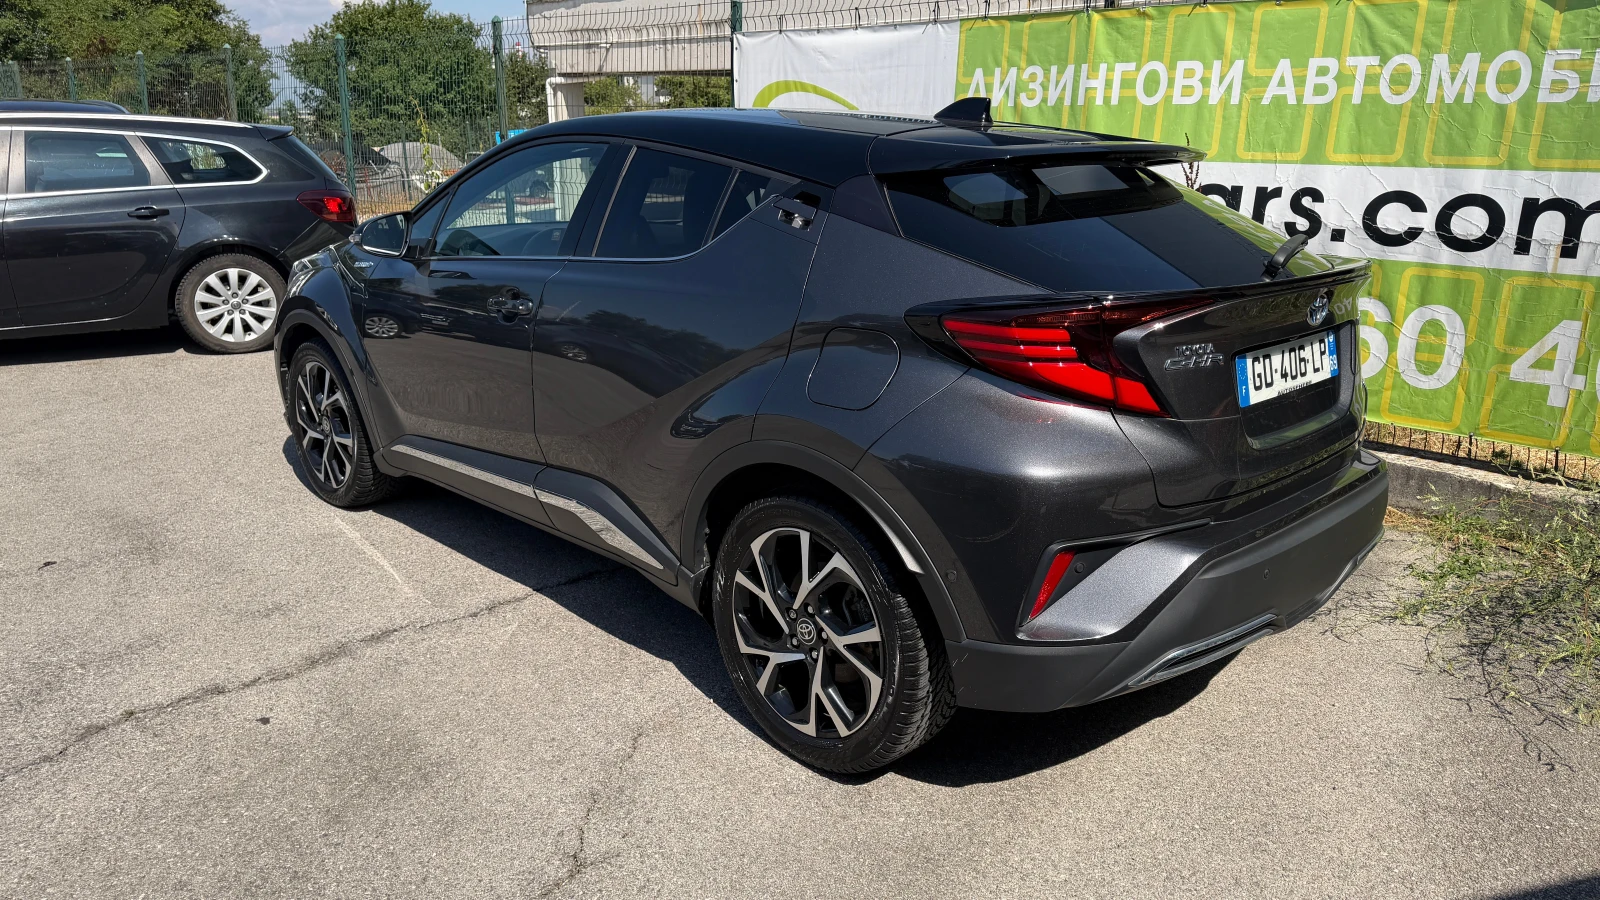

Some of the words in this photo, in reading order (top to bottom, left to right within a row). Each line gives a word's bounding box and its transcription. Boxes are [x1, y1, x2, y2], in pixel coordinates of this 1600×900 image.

[966, 59, 1244, 108] ЛИЗИНГОВИ
[1261, 49, 1600, 106] АВТОМОБ
[1175, 343, 1215, 357] TOYOTA
[1242, 385, 1246, 396] F
